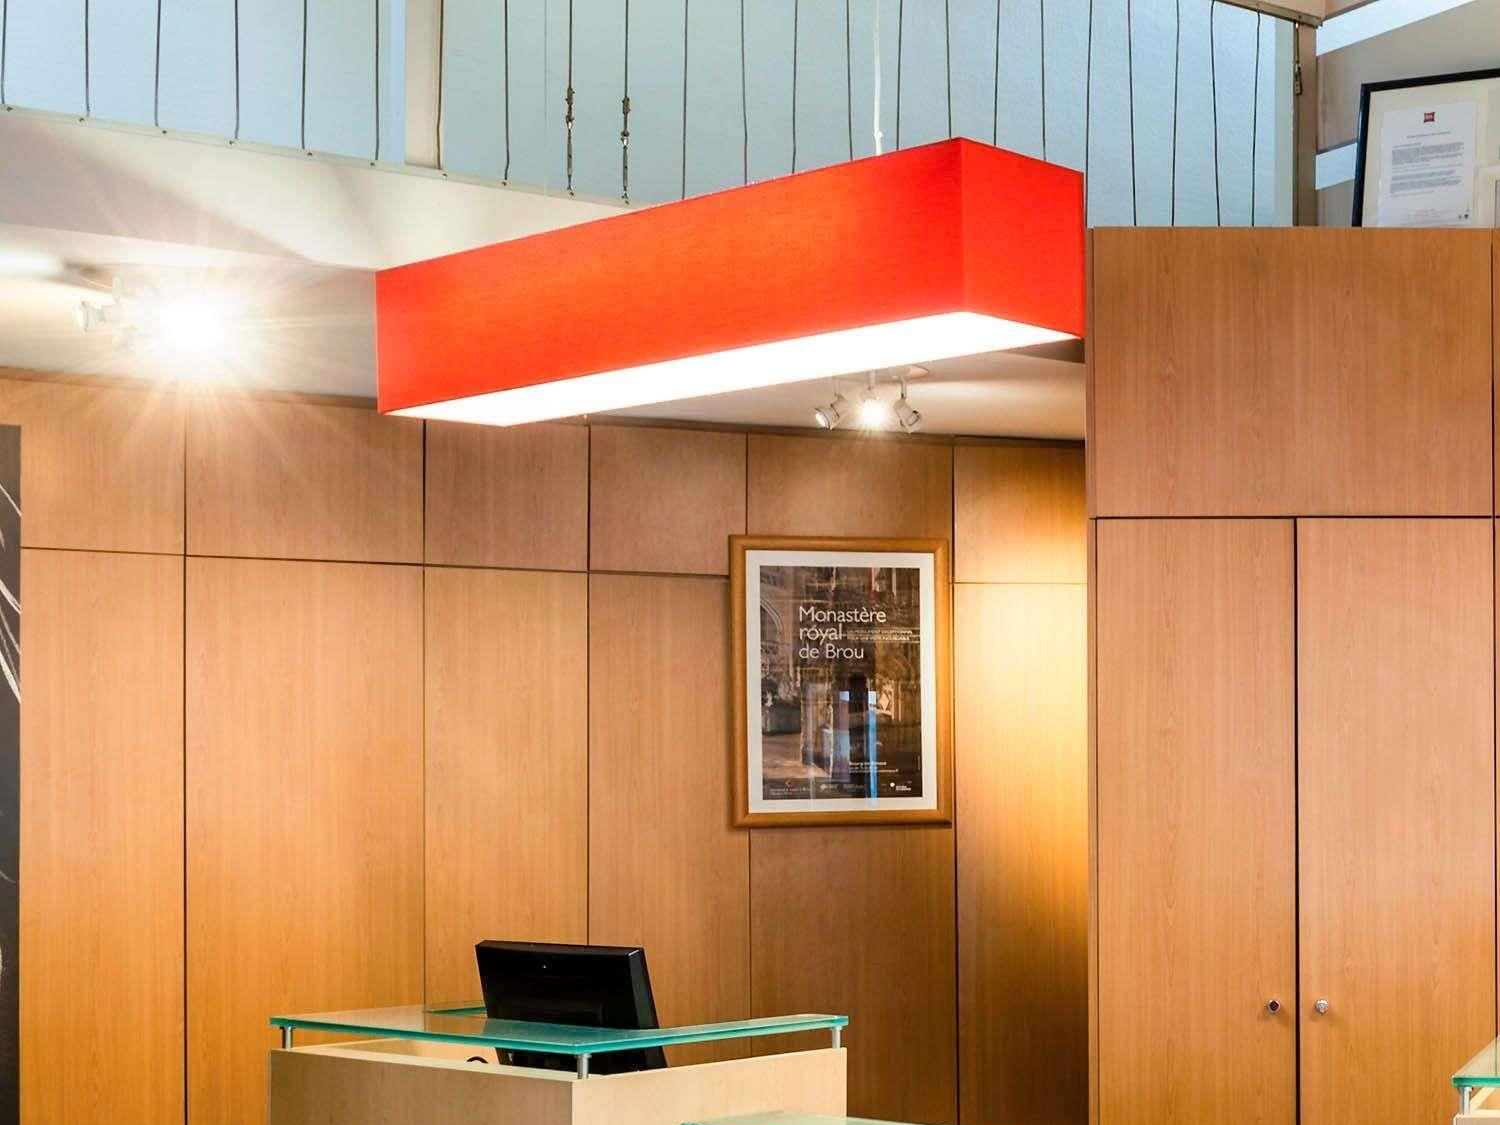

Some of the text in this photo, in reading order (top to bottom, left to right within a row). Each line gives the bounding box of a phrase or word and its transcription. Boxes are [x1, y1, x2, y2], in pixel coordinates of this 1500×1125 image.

[799, 606, 887, 623] Monastère
[799, 623, 843, 646] royal
[799, 643, 864, 660] de Brou
